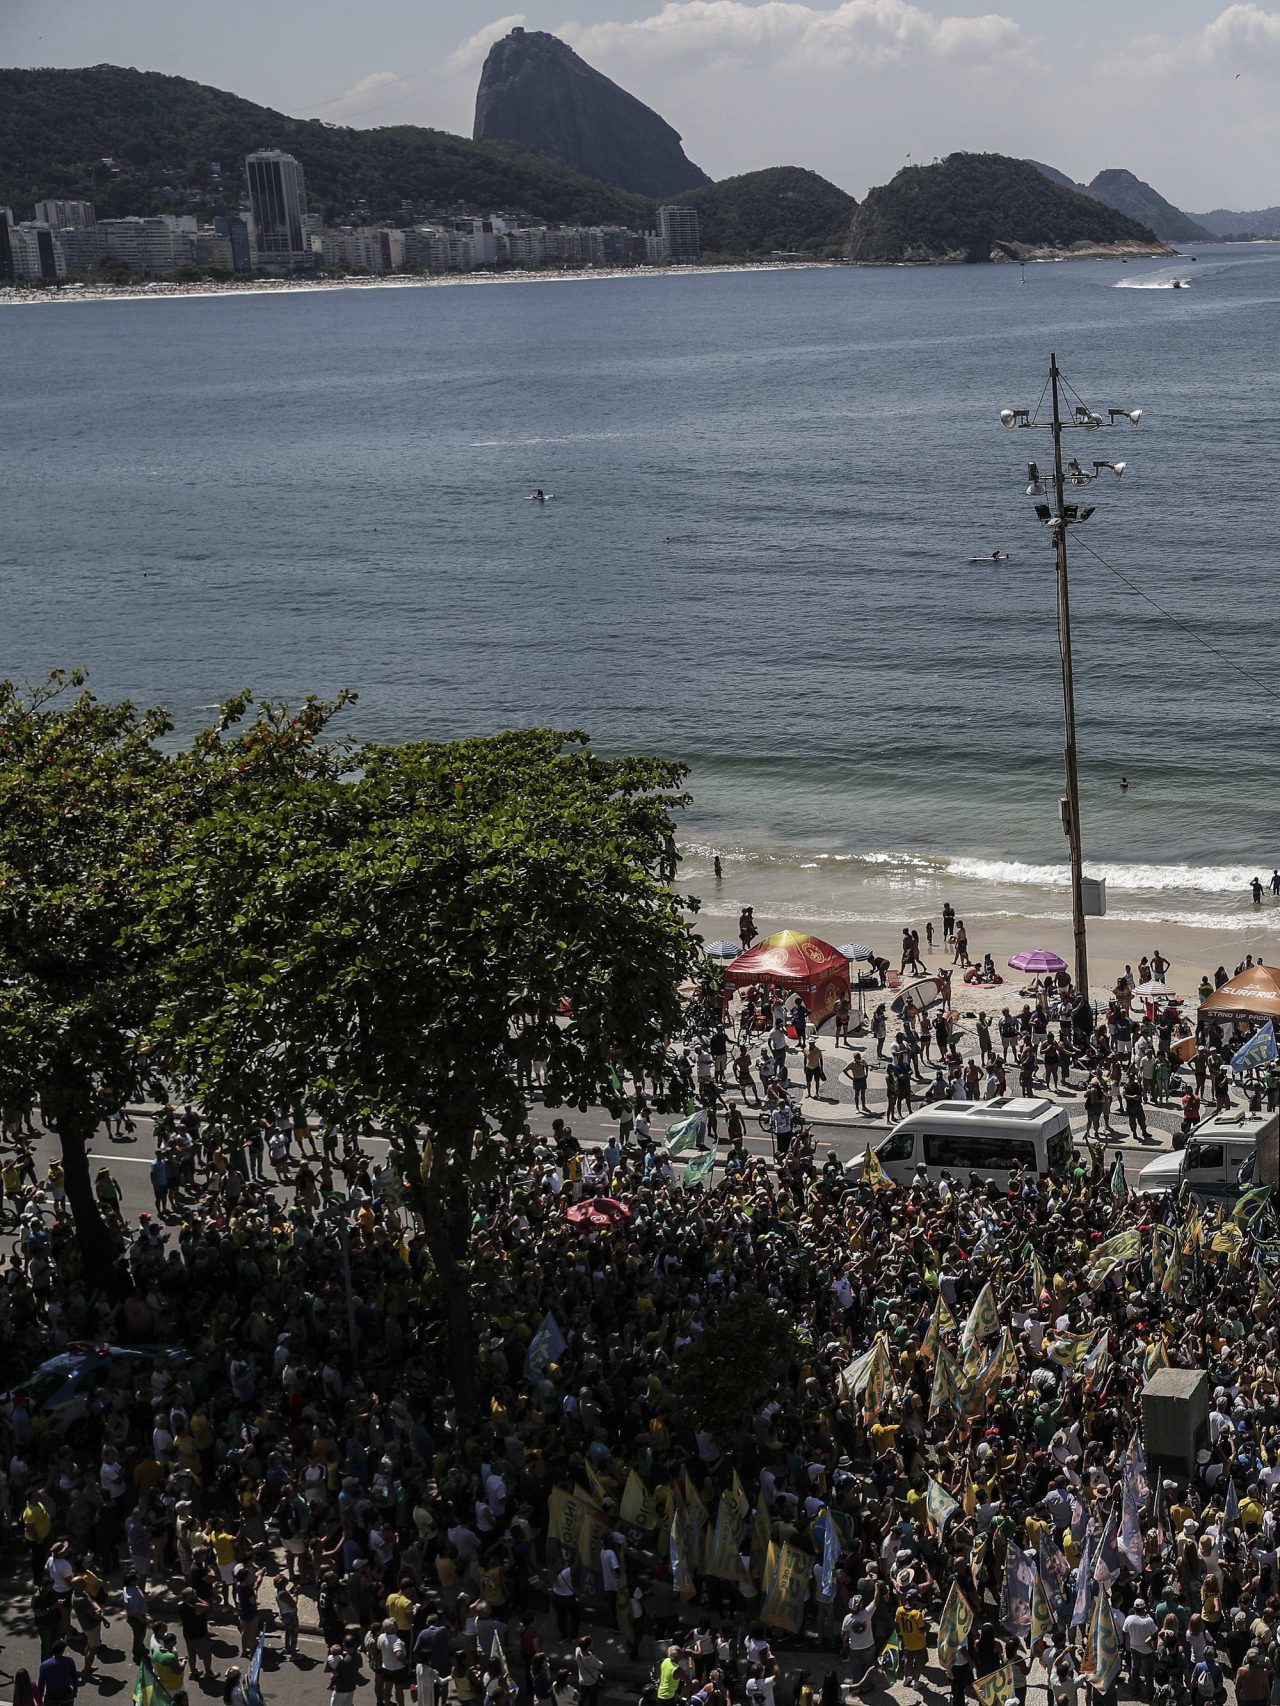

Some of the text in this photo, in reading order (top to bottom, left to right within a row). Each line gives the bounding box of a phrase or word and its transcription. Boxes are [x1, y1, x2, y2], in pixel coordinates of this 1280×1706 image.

[1222, 987, 1278, 999] SURFRIO
[1207, 1011, 1233, 1019] STAND
[902, 1617, 914, 1633] 10
